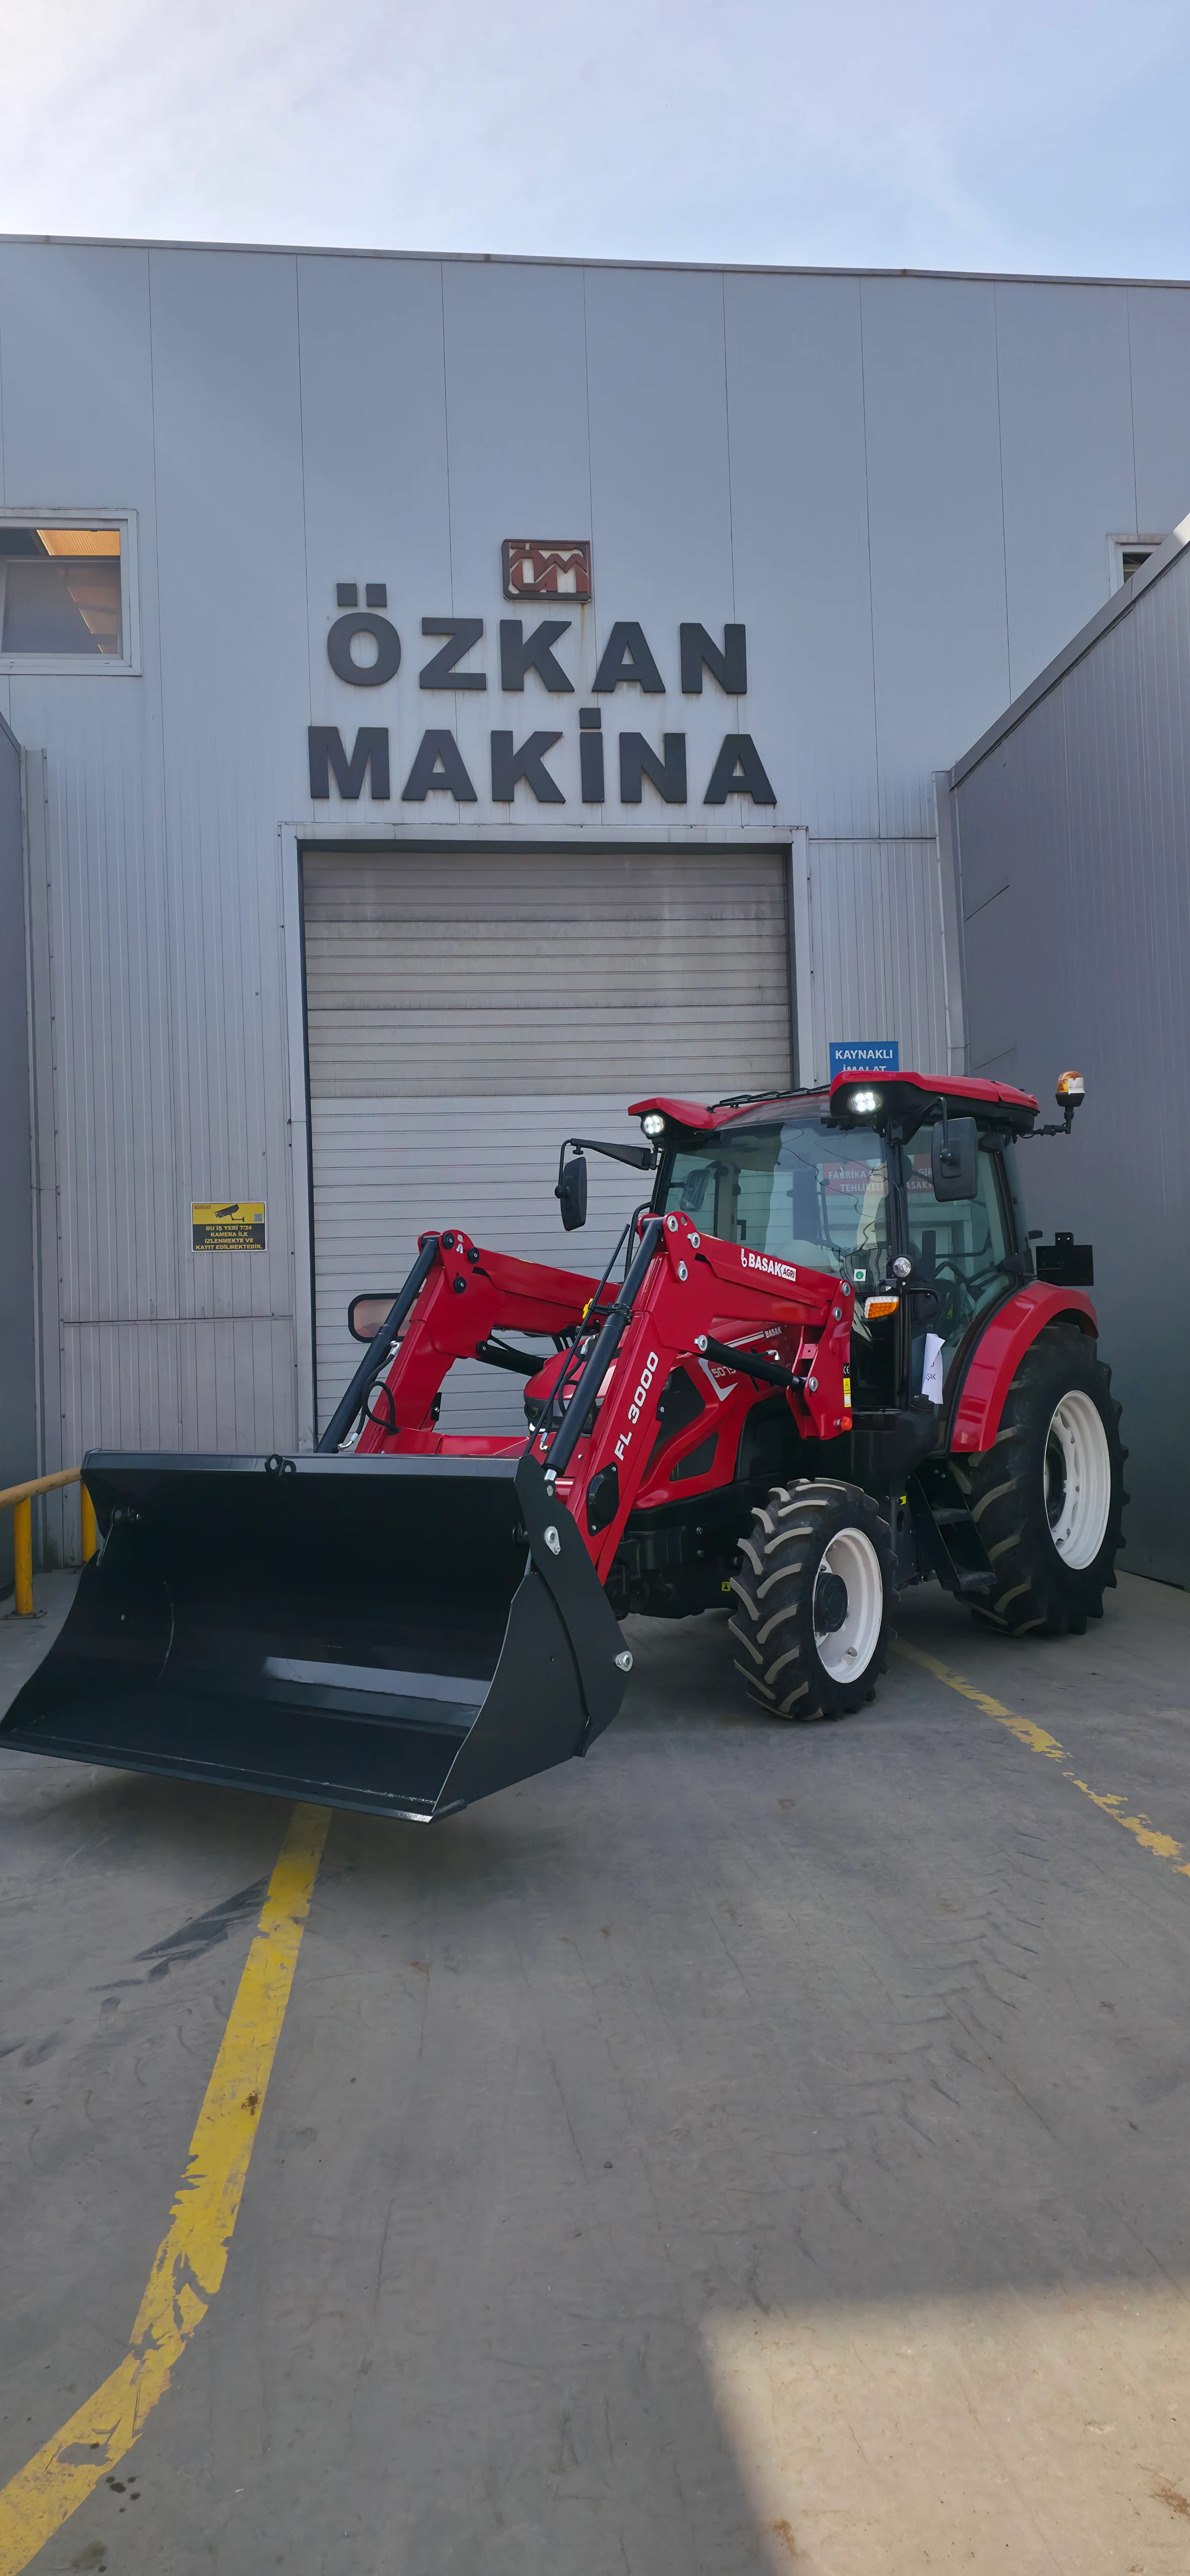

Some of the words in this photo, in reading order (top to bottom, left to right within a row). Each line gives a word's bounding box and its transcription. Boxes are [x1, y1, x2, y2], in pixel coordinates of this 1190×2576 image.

[327, 582, 747, 694] ÖZKAN
[307, 707, 777, 804] MAKİNA
[835, 1049, 892, 1059] KAYNAKLI
[829, 1169, 867, 1179] FABRİKA
[783, 1267, 795, 1279] AGRI
[765, 1326, 782, 1338] BASAK
[614, 1431, 632, 1461] FL
[628, 1351, 658, 1424] 3000
